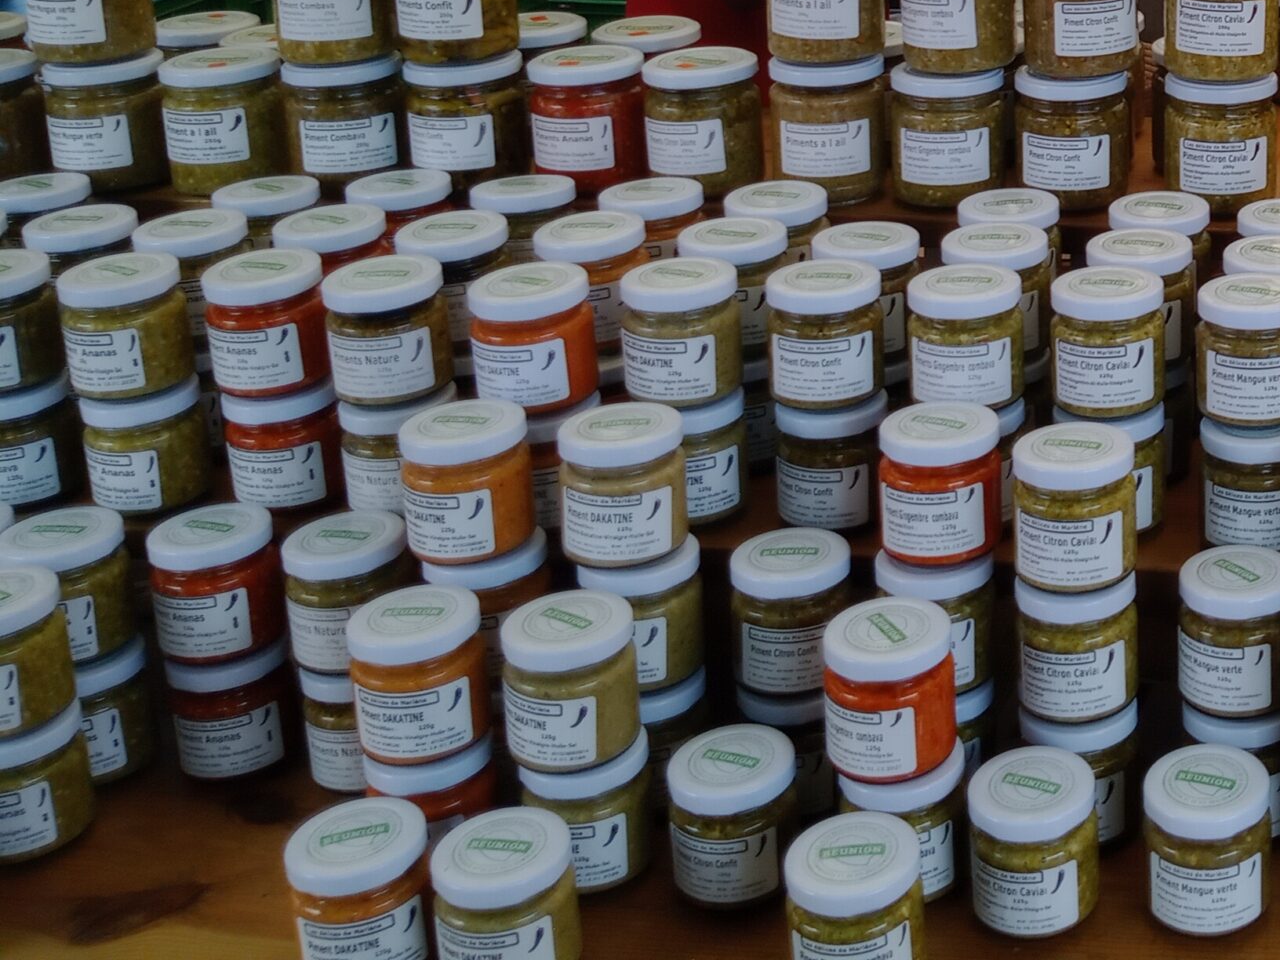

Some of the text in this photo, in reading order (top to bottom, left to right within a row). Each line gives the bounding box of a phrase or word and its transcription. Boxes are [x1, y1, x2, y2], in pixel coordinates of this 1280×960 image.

[425, 0, 453, 11] Confit
[1064, 16, 1084, 27] Piment
[1179, 10, 1200, 22] Piment
[1201, 13, 1223, 24] Citron
[330, 132, 366, 142] Combava
[786, 136, 819, 148] Piments
[1183, 151, 1202, 163] Piment
[1204, 152, 1225, 163] Citron
[81, 346, 117, 358] Ananas
[227, 346, 258, 356] Ananas
[365, 353, 400, 365] Nature
[820, 356, 842, 368] Confit
[1059, 357, 1080, 369] Piment
[1081, 359, 1104, 371] Citron
[487, 365, 520, 377] DAKATINE
[1212, 367, 1234, 381] Piment
[1236, 371, 1266, 386] Mangue
[101, 468, 136, 478] Ananas
[366, 475, 399, 486] Nature
[1210, 497, 1231, 513] Piment
[1232, 503, 1261, 518] Mangue
[413, 512, 446, 524] DAKATINE
[590, 512, 633, 523] DAKATINE
[1042, 532, 1069, 546] Citron
[760, 547, 819, 556] REUNION
[172, 612, 205, 623] Ananas
[774, 644, 796, 658] Citron
[1046, 664, 1071, 679] Citron
[1221, 664, 1243, 674] verte
[382, 711, 424, 725] DAKATINE
[514, 713, 547, 732] DAKATINE
[205, 732, 242, 743] Ananas
[1003, 773, 1059, 793] REUNION
[1178, 771, 1232, 789] REUNION
[321, 823, 389, 845] REUNION
[469, 838, 529, 853] REUNION
[821, 844, 882, 858] REUNION
[714, 857, 738, 870] Confit
[993, 880, 1017, 896] Citron
[1156, 871, 1237, 896] Piment Mangue verte
[334, 937, 380, 952] DAKATINE
